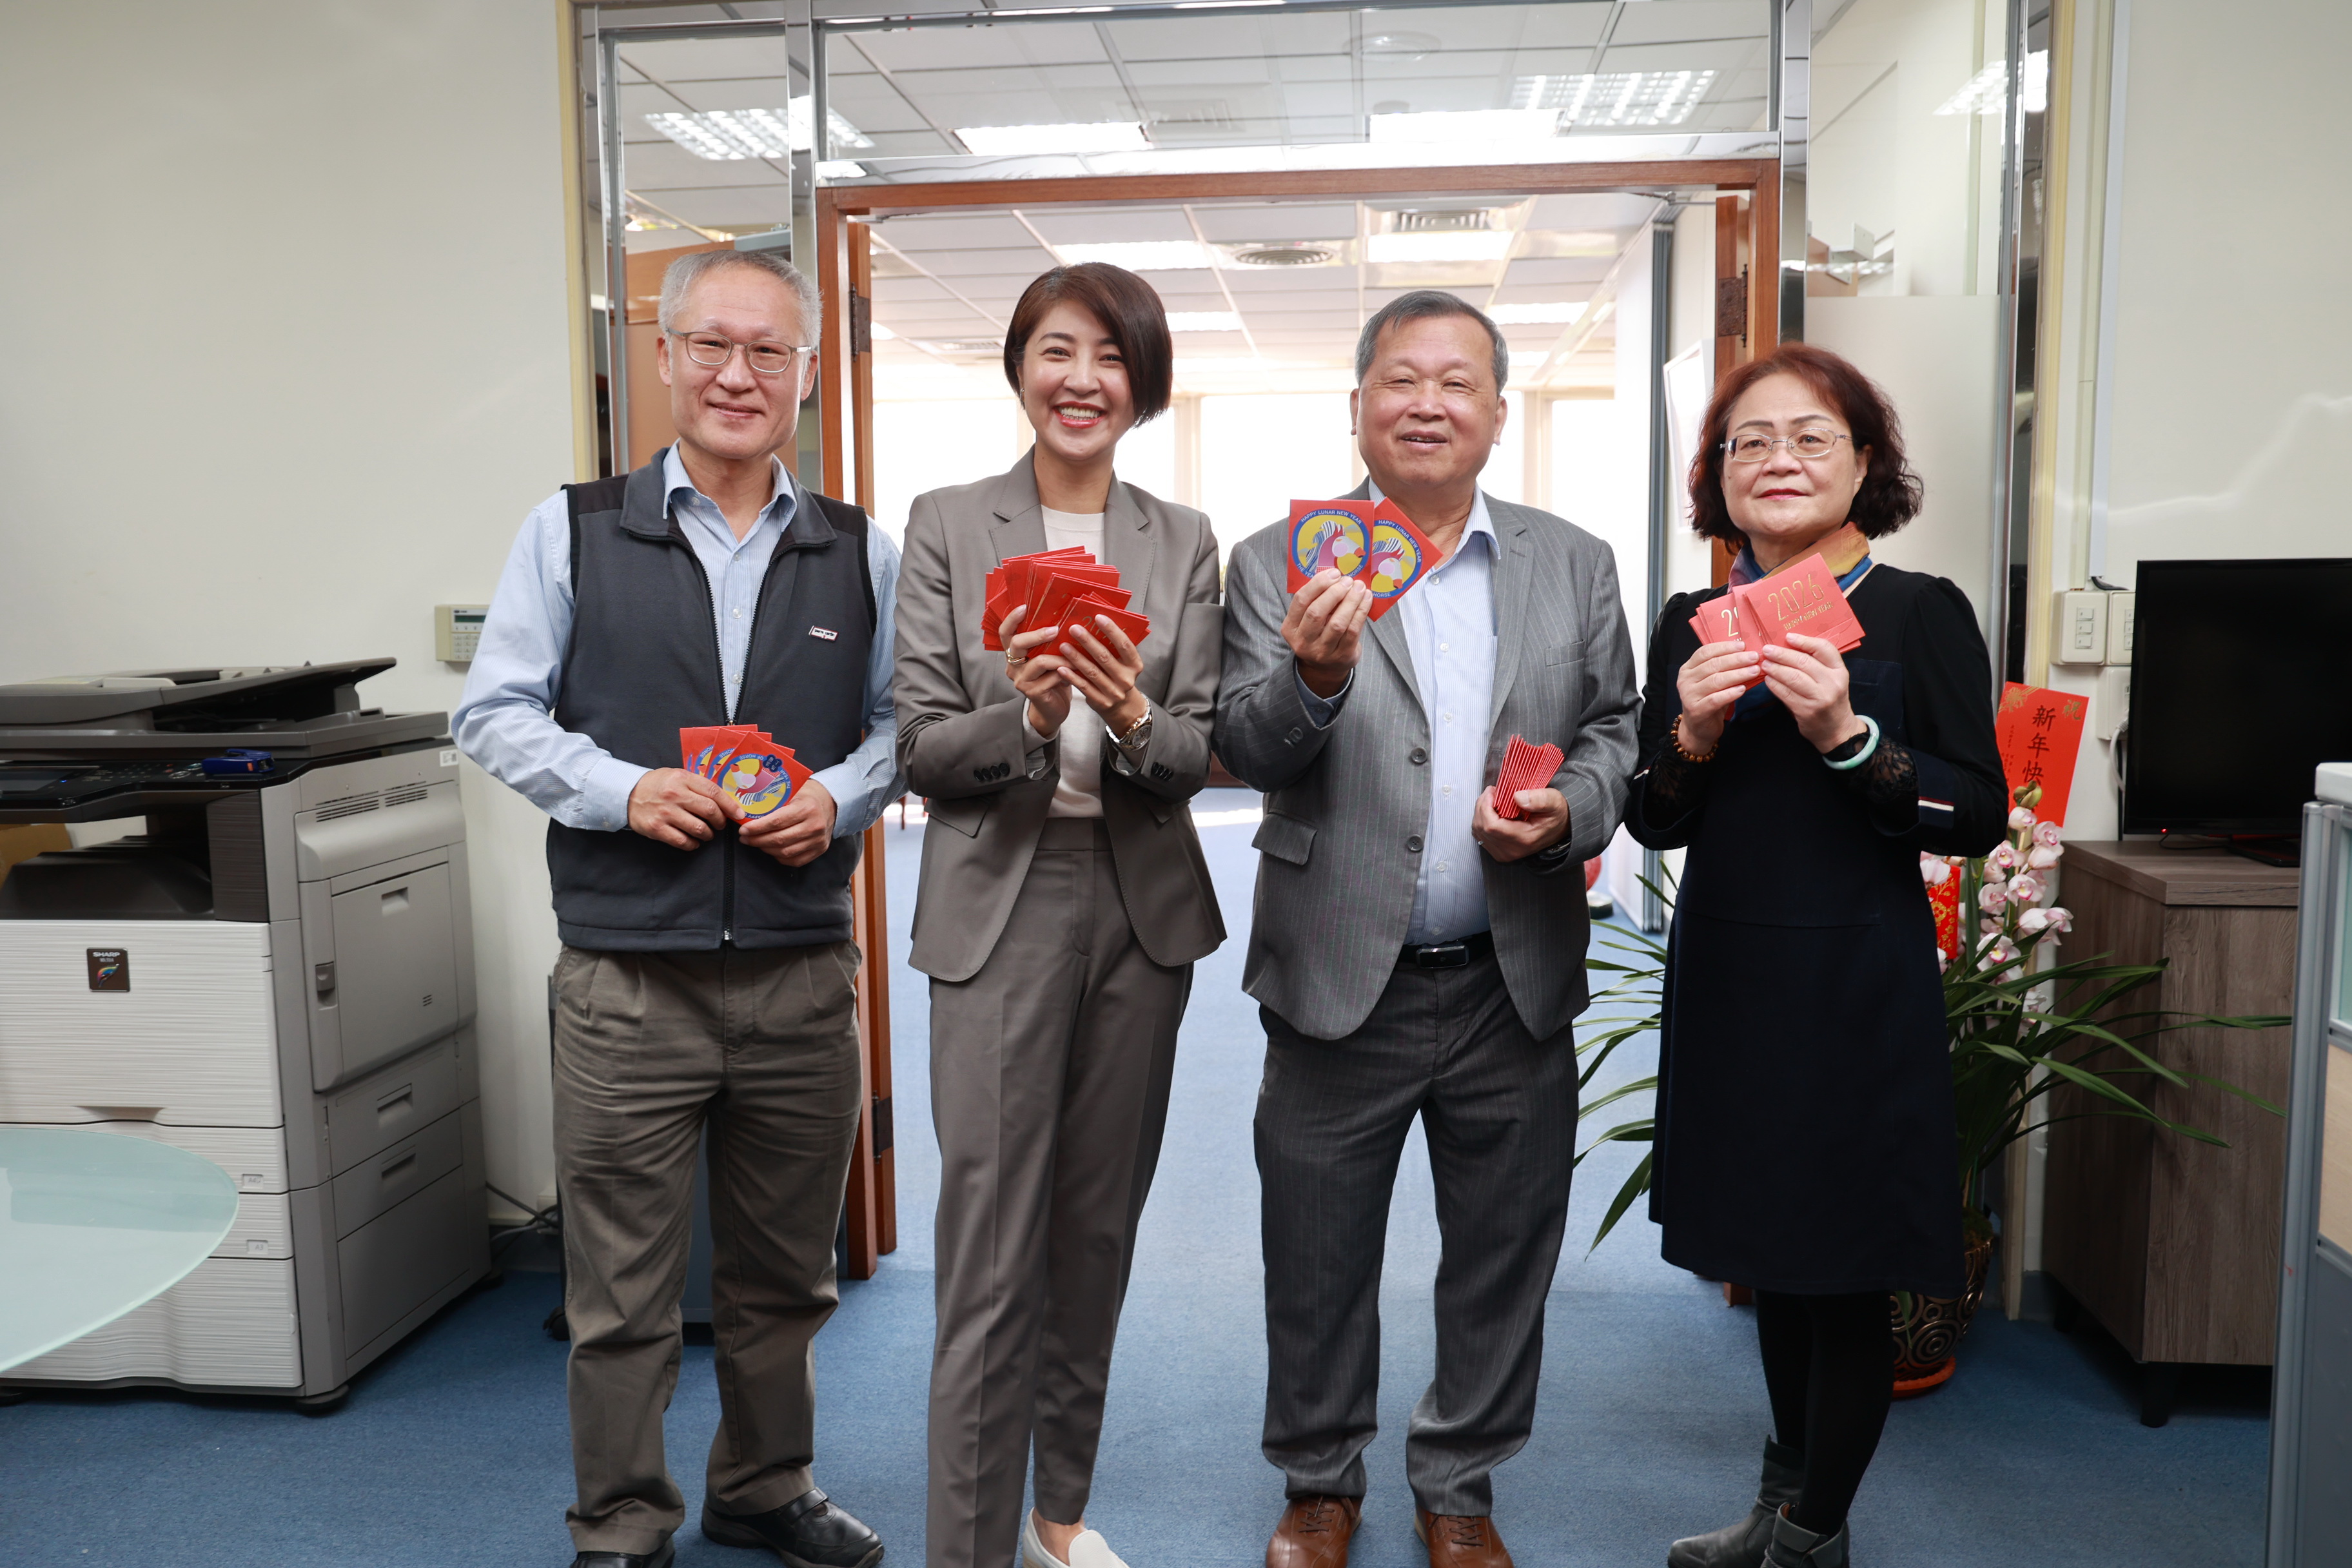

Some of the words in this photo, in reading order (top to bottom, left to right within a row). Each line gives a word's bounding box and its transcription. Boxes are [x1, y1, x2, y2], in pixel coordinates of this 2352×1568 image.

[1301, 511, 1316, 522] HAPPY
[1350, 513, 1362, 525] YEAR
[1395, 525, 1410, 539] LUNAR
[1408, 538, 1418, 549] NEW
[1297, 563, 1306, 572] THE
[1768, 574, 1824, 621] 2026
[1783, 615, 1803, 631] HAPPY
[1803, 608, 1818, 621] NEW
[1818, 602, 1834, 613] YEAR
[2023, 705, 2056, 787] 新年快
[780, 769, 789, 780] YEAR
